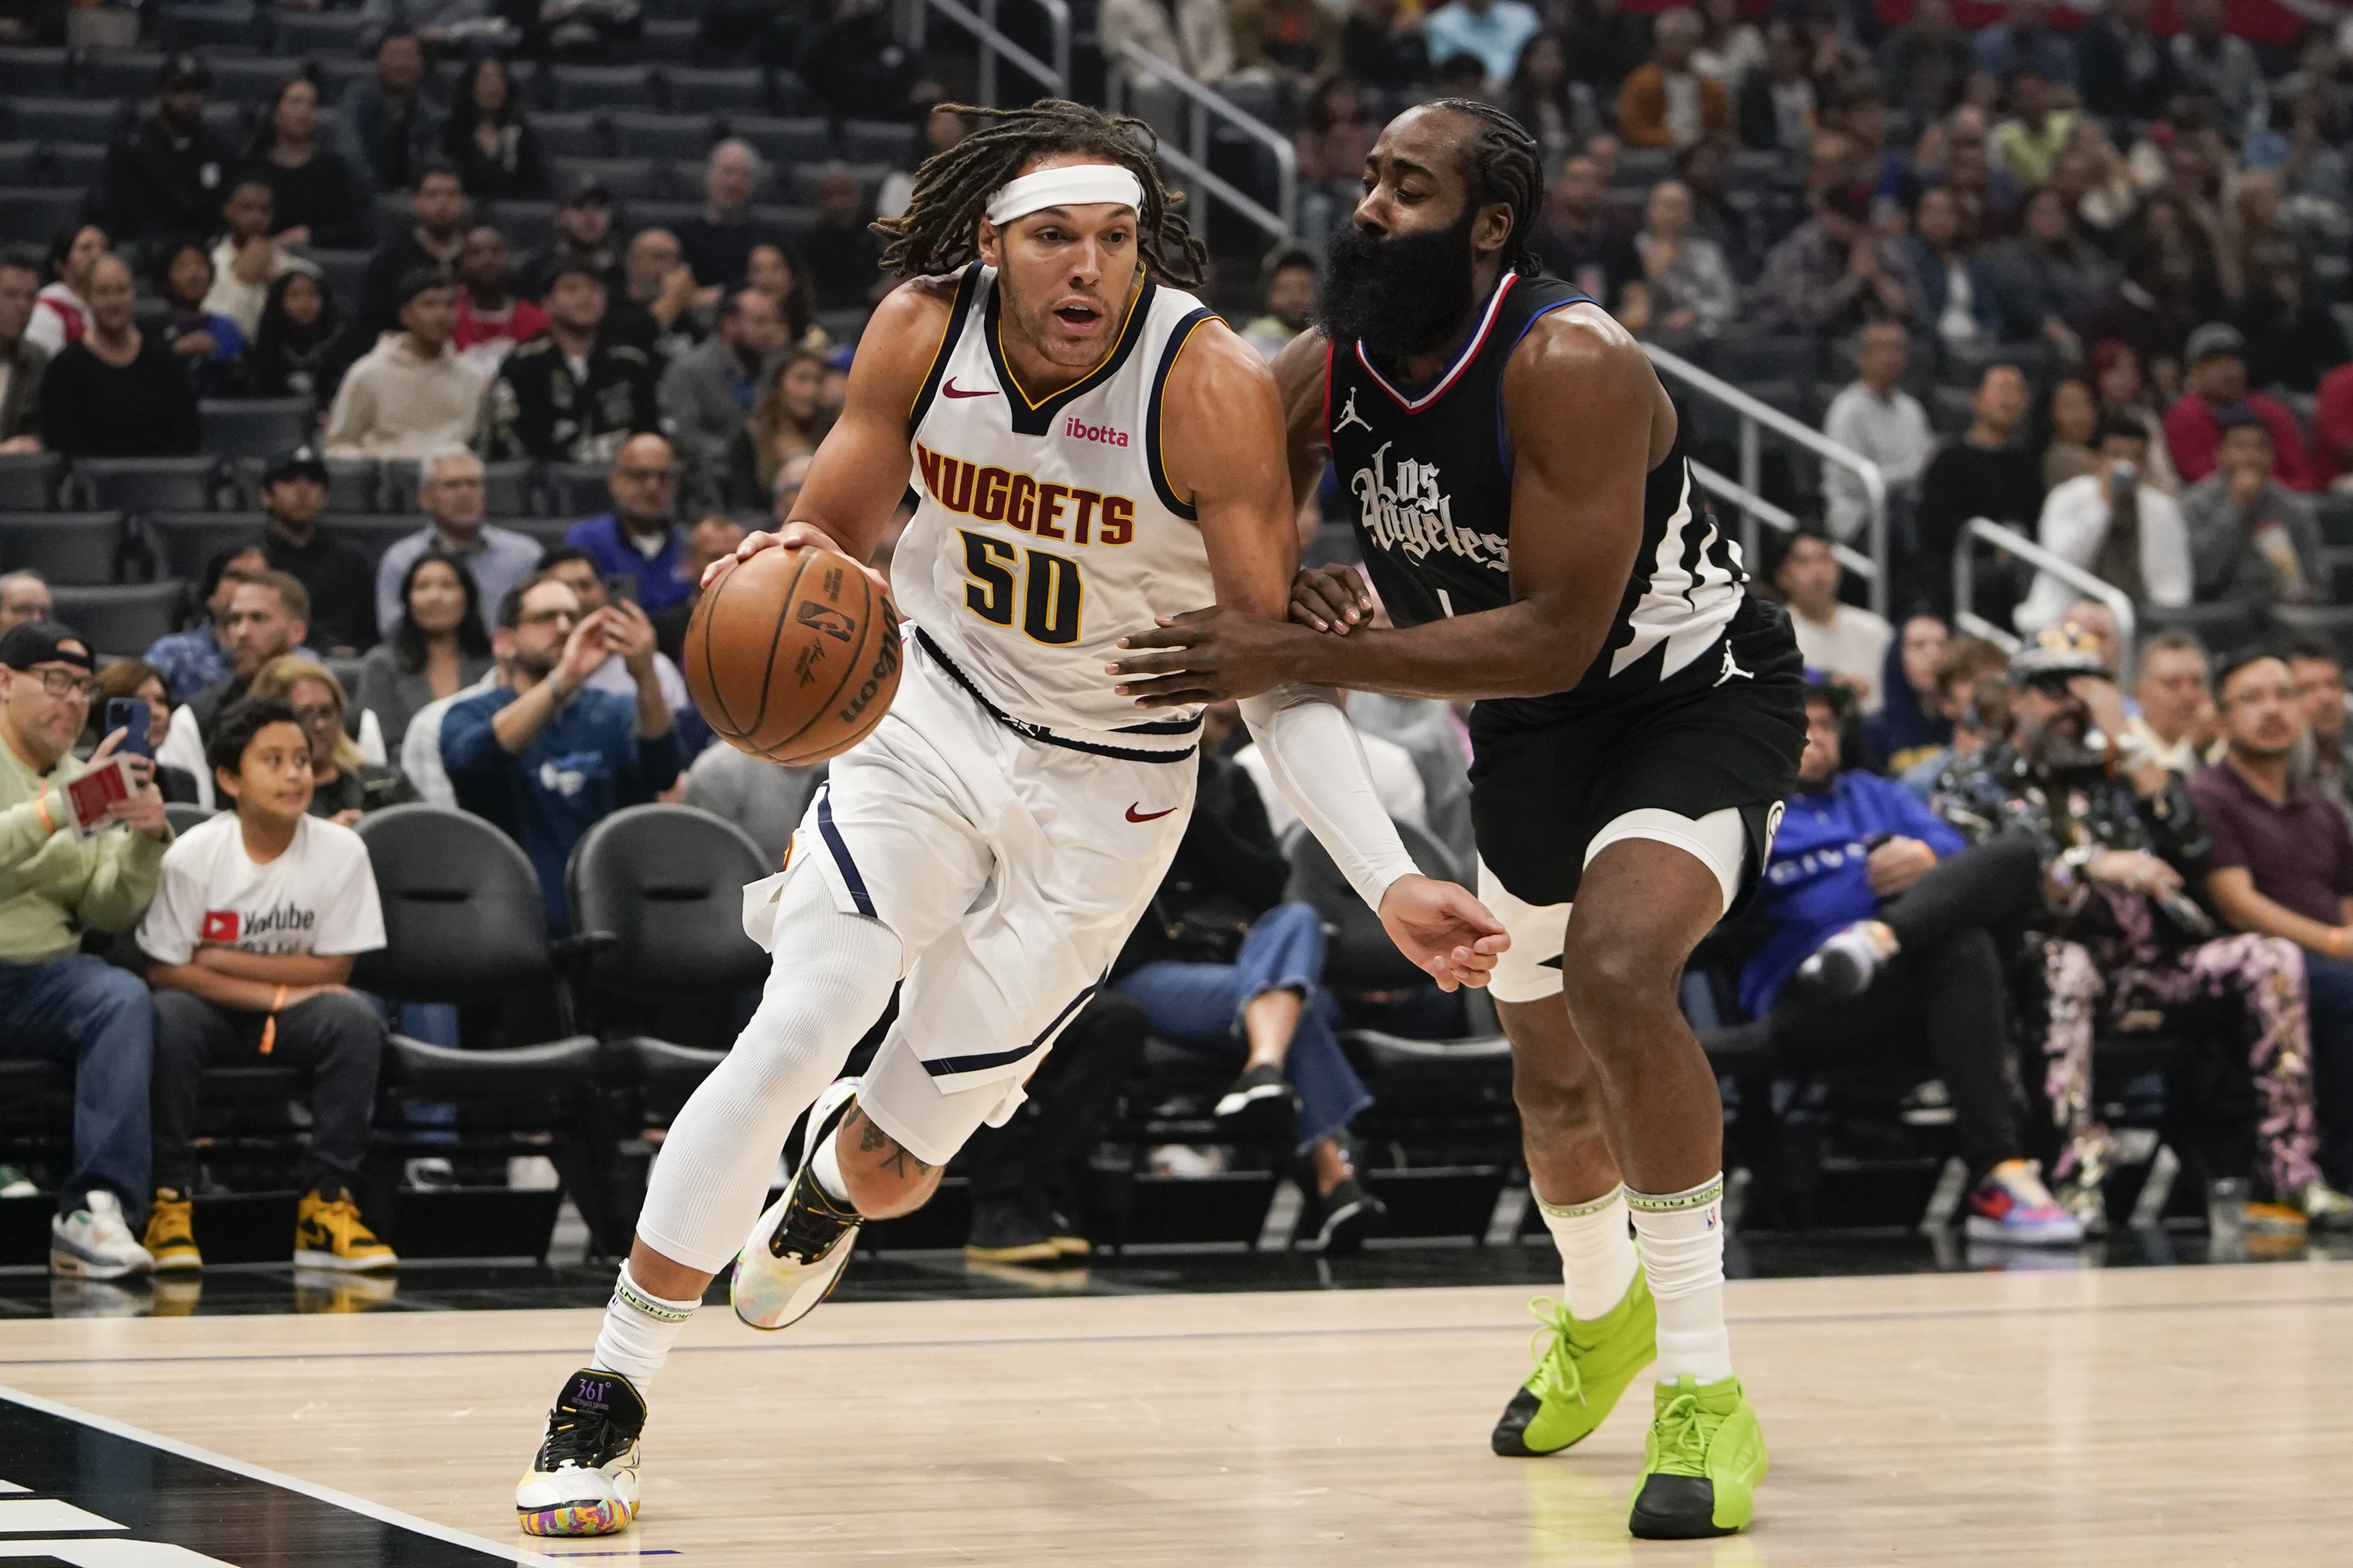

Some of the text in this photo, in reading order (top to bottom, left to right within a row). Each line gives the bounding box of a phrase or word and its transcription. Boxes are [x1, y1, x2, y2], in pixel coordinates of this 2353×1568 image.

[1066, 416, 1128, 447] ibotta
[1372, 440, 1440, 512] Los
[915, 440, 1135, 546] NUGGETS
[1351, 467, 1509, 573] Angeles
[956, 527, 1085, 646] 50
[244, 900, 315, 936] YoTube
